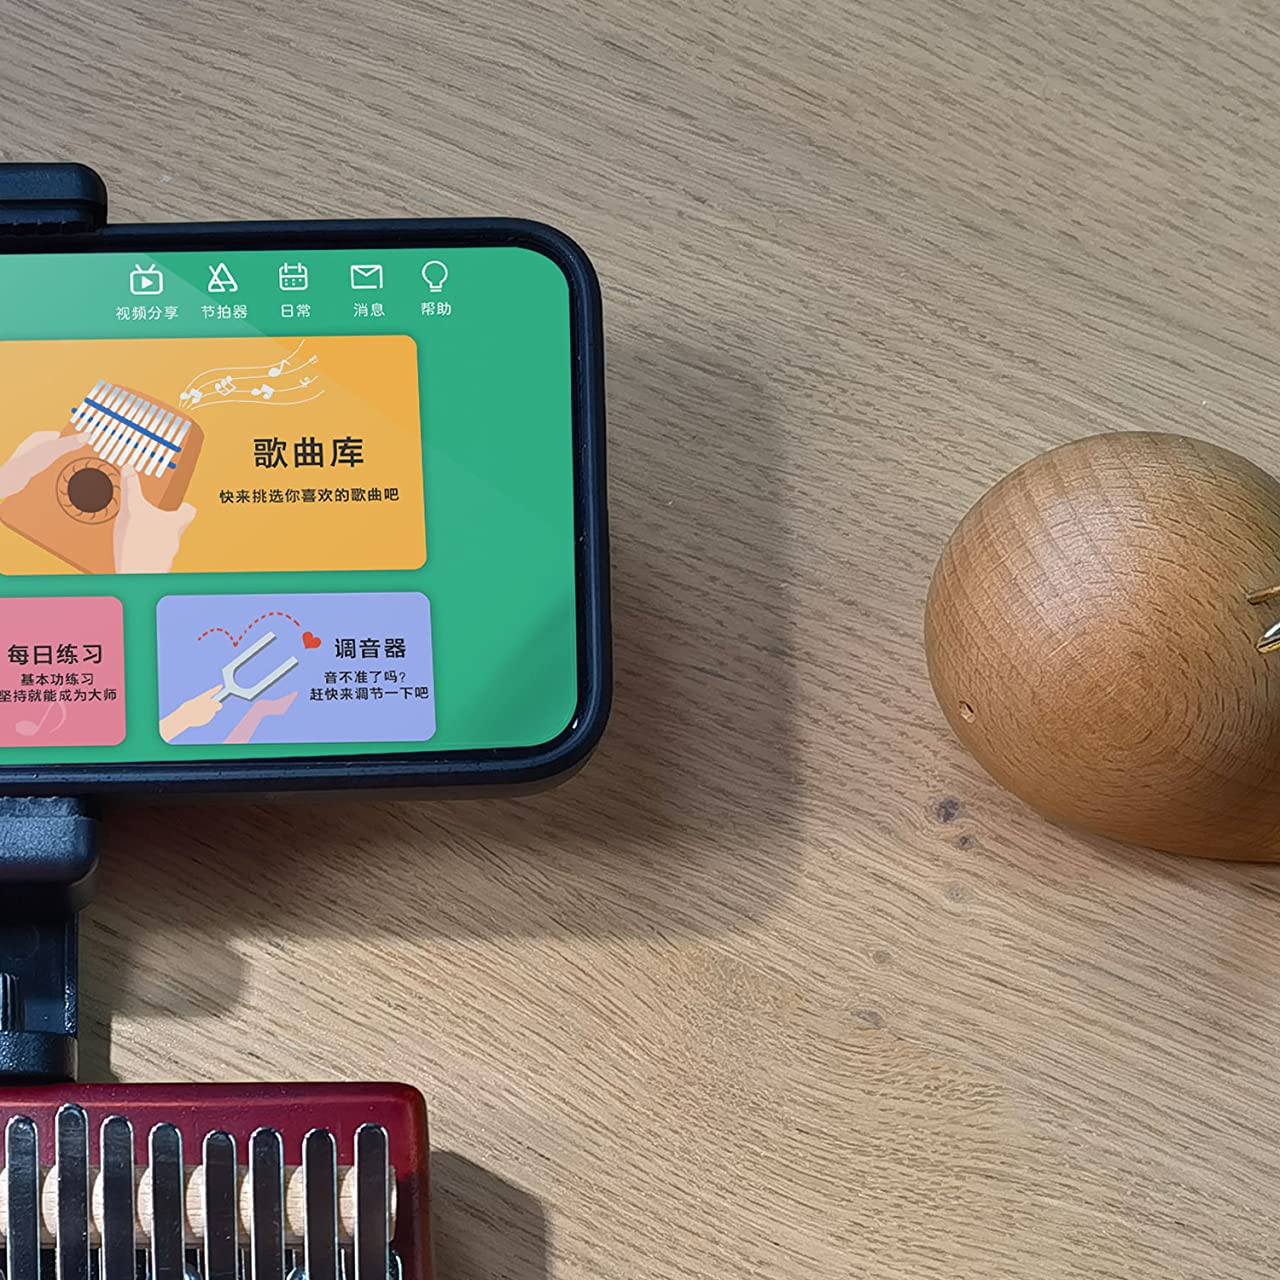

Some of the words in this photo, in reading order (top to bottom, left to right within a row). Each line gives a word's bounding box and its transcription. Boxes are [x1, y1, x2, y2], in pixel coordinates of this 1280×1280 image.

[115, 304, 180, 322] 视频分享
[200, 304, 249, 320] 节拍器
[280, 303, 312, 319] 日常
[352, 301, 386, 318] 消息
[420, 301, 452, 318] 帮助
[252, 435, 366, 469] 歌曲库
[218, 486, 400, 505] 快来挑选你喜欢的歌曲吧
[7, 643, 104, 667] 每日练习
[334, 636, 407, 660] 调音器
[20, 671, 95, 687] 基本功练习
[309, 685, 430, 702] 赶快来调节一下吧
